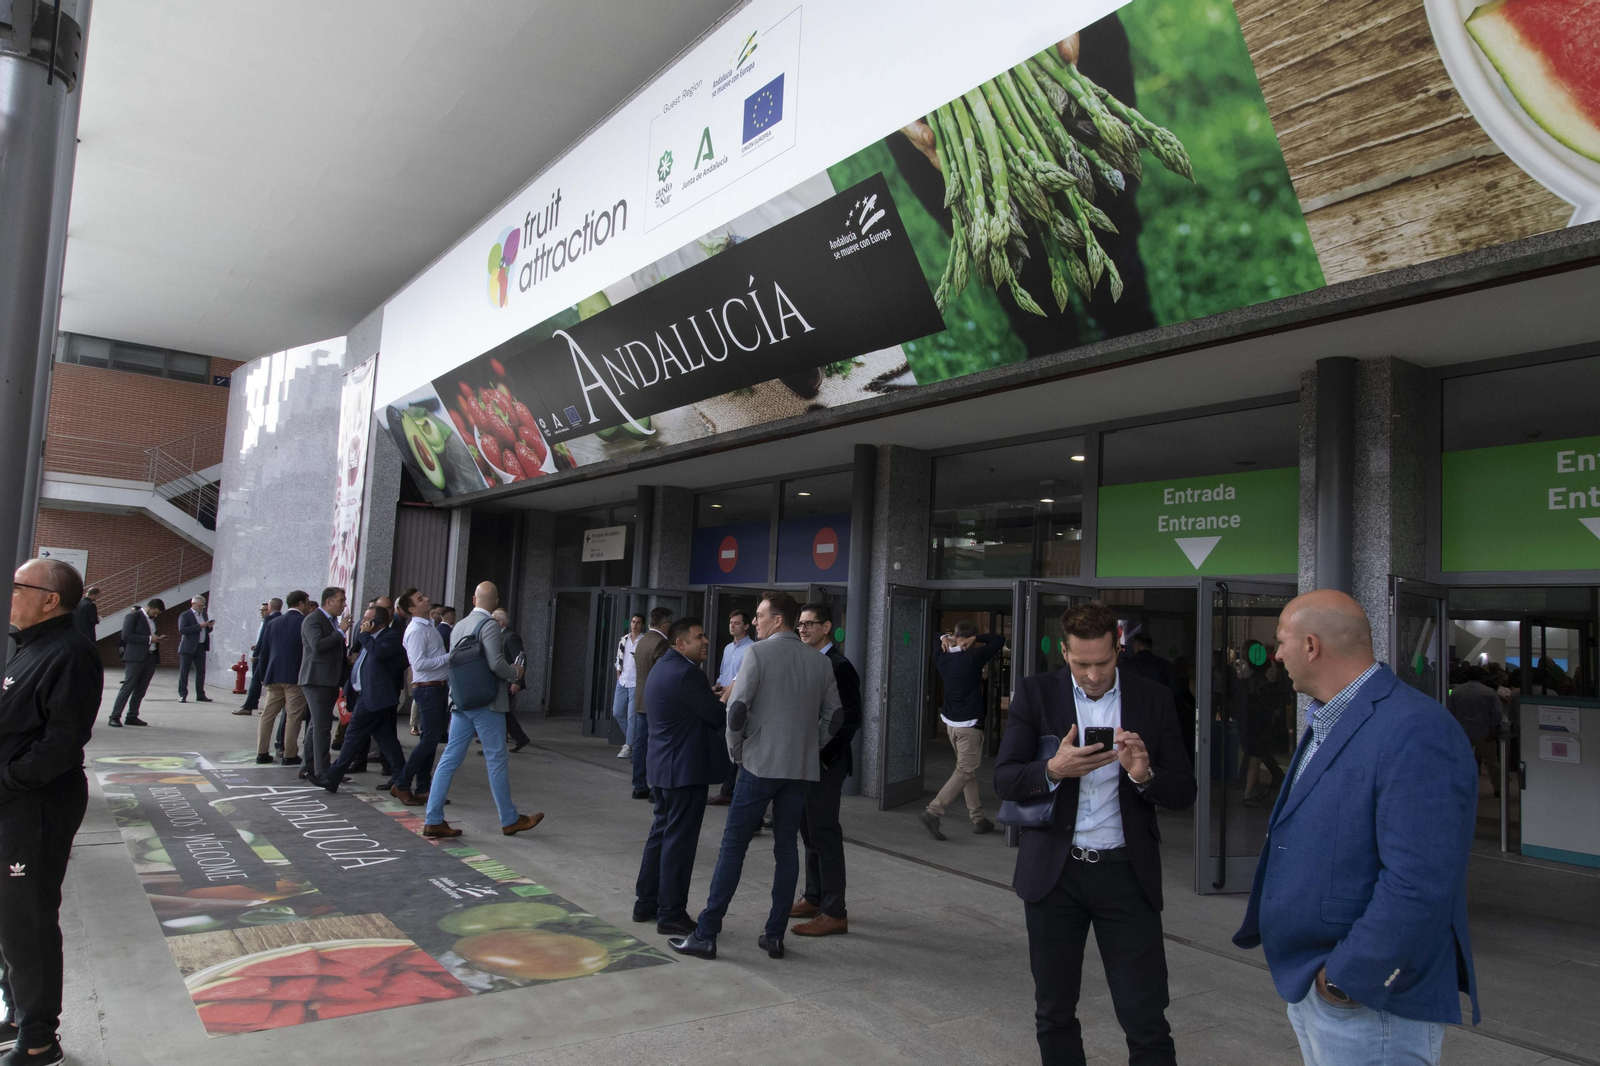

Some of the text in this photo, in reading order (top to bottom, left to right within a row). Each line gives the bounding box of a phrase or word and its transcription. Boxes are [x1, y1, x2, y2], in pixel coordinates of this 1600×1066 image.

[739, 61, 755, 78] Europa
[663, 79, 703, 114] Guest Region
[682, 175, 696, 190] Junta
[695, 170, 702, 182] de
[523, 187, 562, 250] fruit
[518, 198, 628, 293] attraction
[833, 228, 892, 260] se mueve con Europa
[551, 274, 816, 436] ANDALUCÍA
[1557, 450, 1600, 474] En
[1163, 483, 1236, 506] Entrada
[1158, 514, 1242, 533] Entrance
[172, 832, 249, 882] WELCOME
